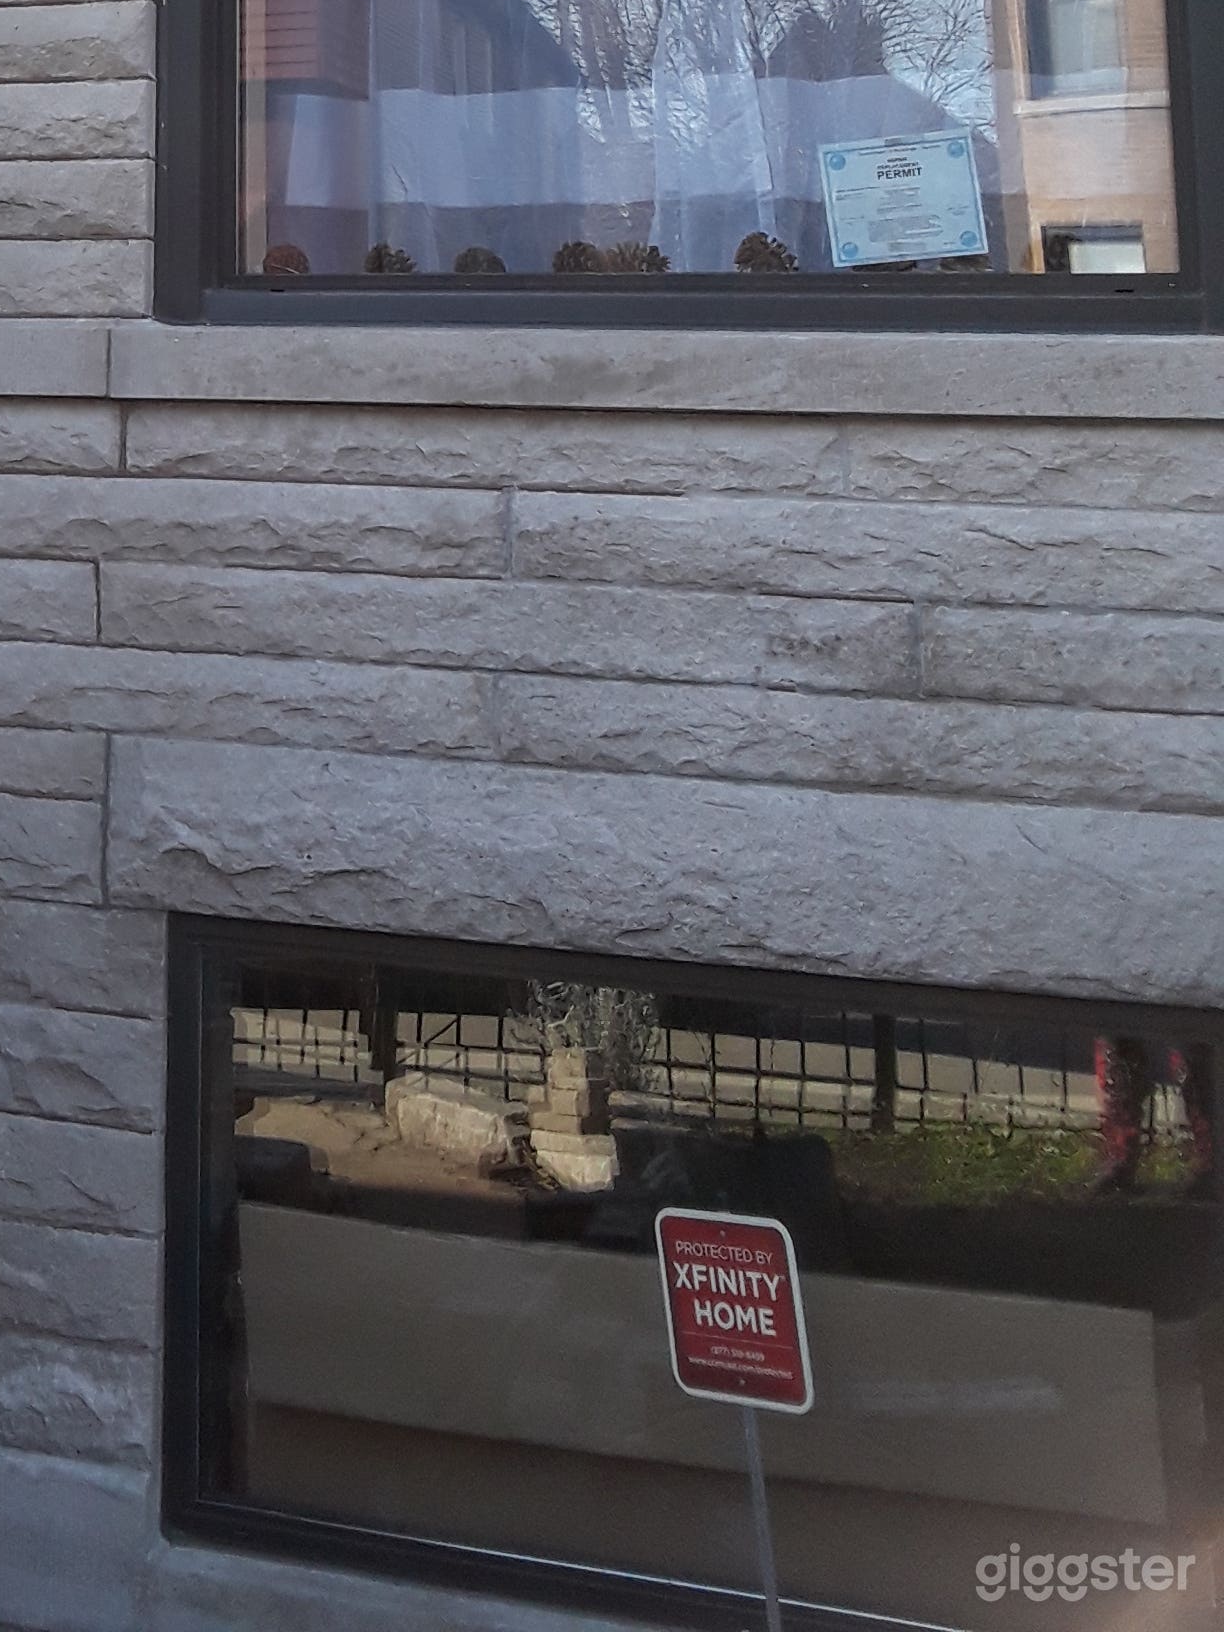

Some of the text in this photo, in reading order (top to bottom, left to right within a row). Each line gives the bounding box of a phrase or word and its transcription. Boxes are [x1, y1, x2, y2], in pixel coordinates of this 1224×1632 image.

[877, 167, 922, 180] PERMIT
[676, 1240, 773, 1265] PROTECTED BY
[673, 1261, 780, 1302] XFINITY
[694, 1299, 776, 1336] HOME
